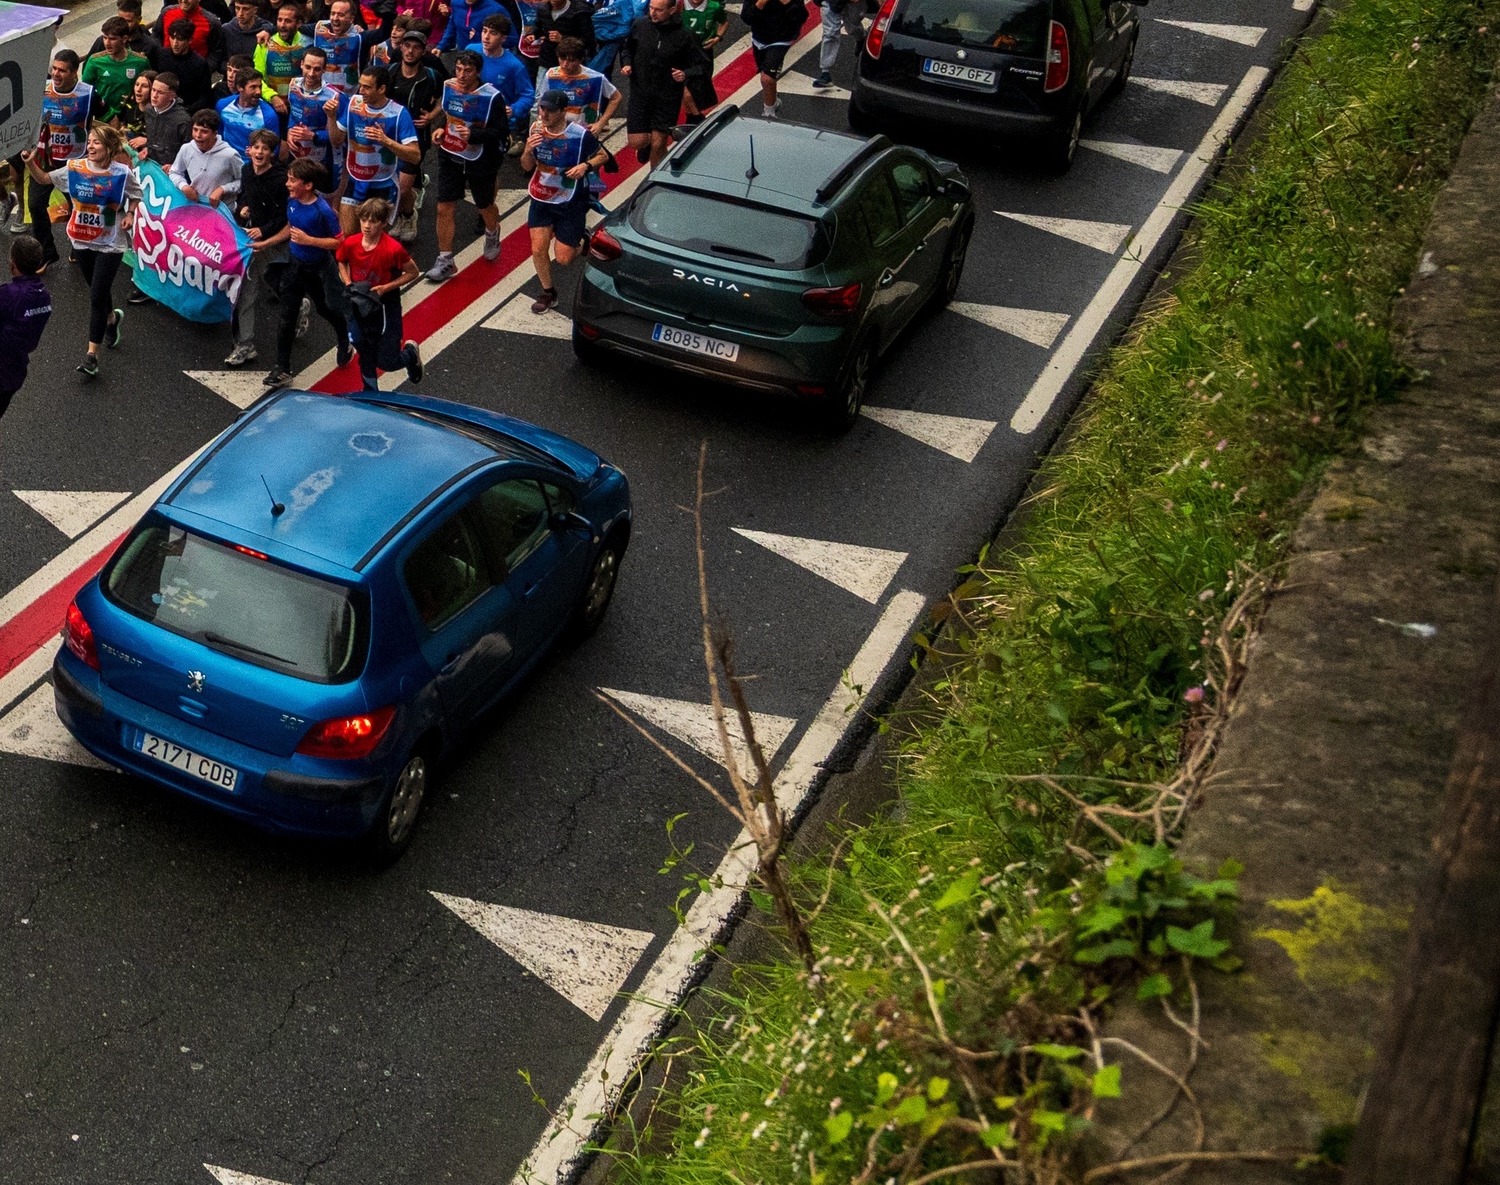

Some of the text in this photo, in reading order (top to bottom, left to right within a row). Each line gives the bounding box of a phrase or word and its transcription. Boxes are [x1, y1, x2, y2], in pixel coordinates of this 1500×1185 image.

[690, 18, 697, 27] 7
[932, 62, 993, 83] 0837 GFZ
[51, 133, 71, 145] 1824
[78, 213, 101, 226] 1824
[174, 225, 223, 265] 24.korrika
[167, 243, 242, 304] gara
[663, 328, 736, 358] 8085 NCJ
[147, 736, 236, 788] 2171 CDB
